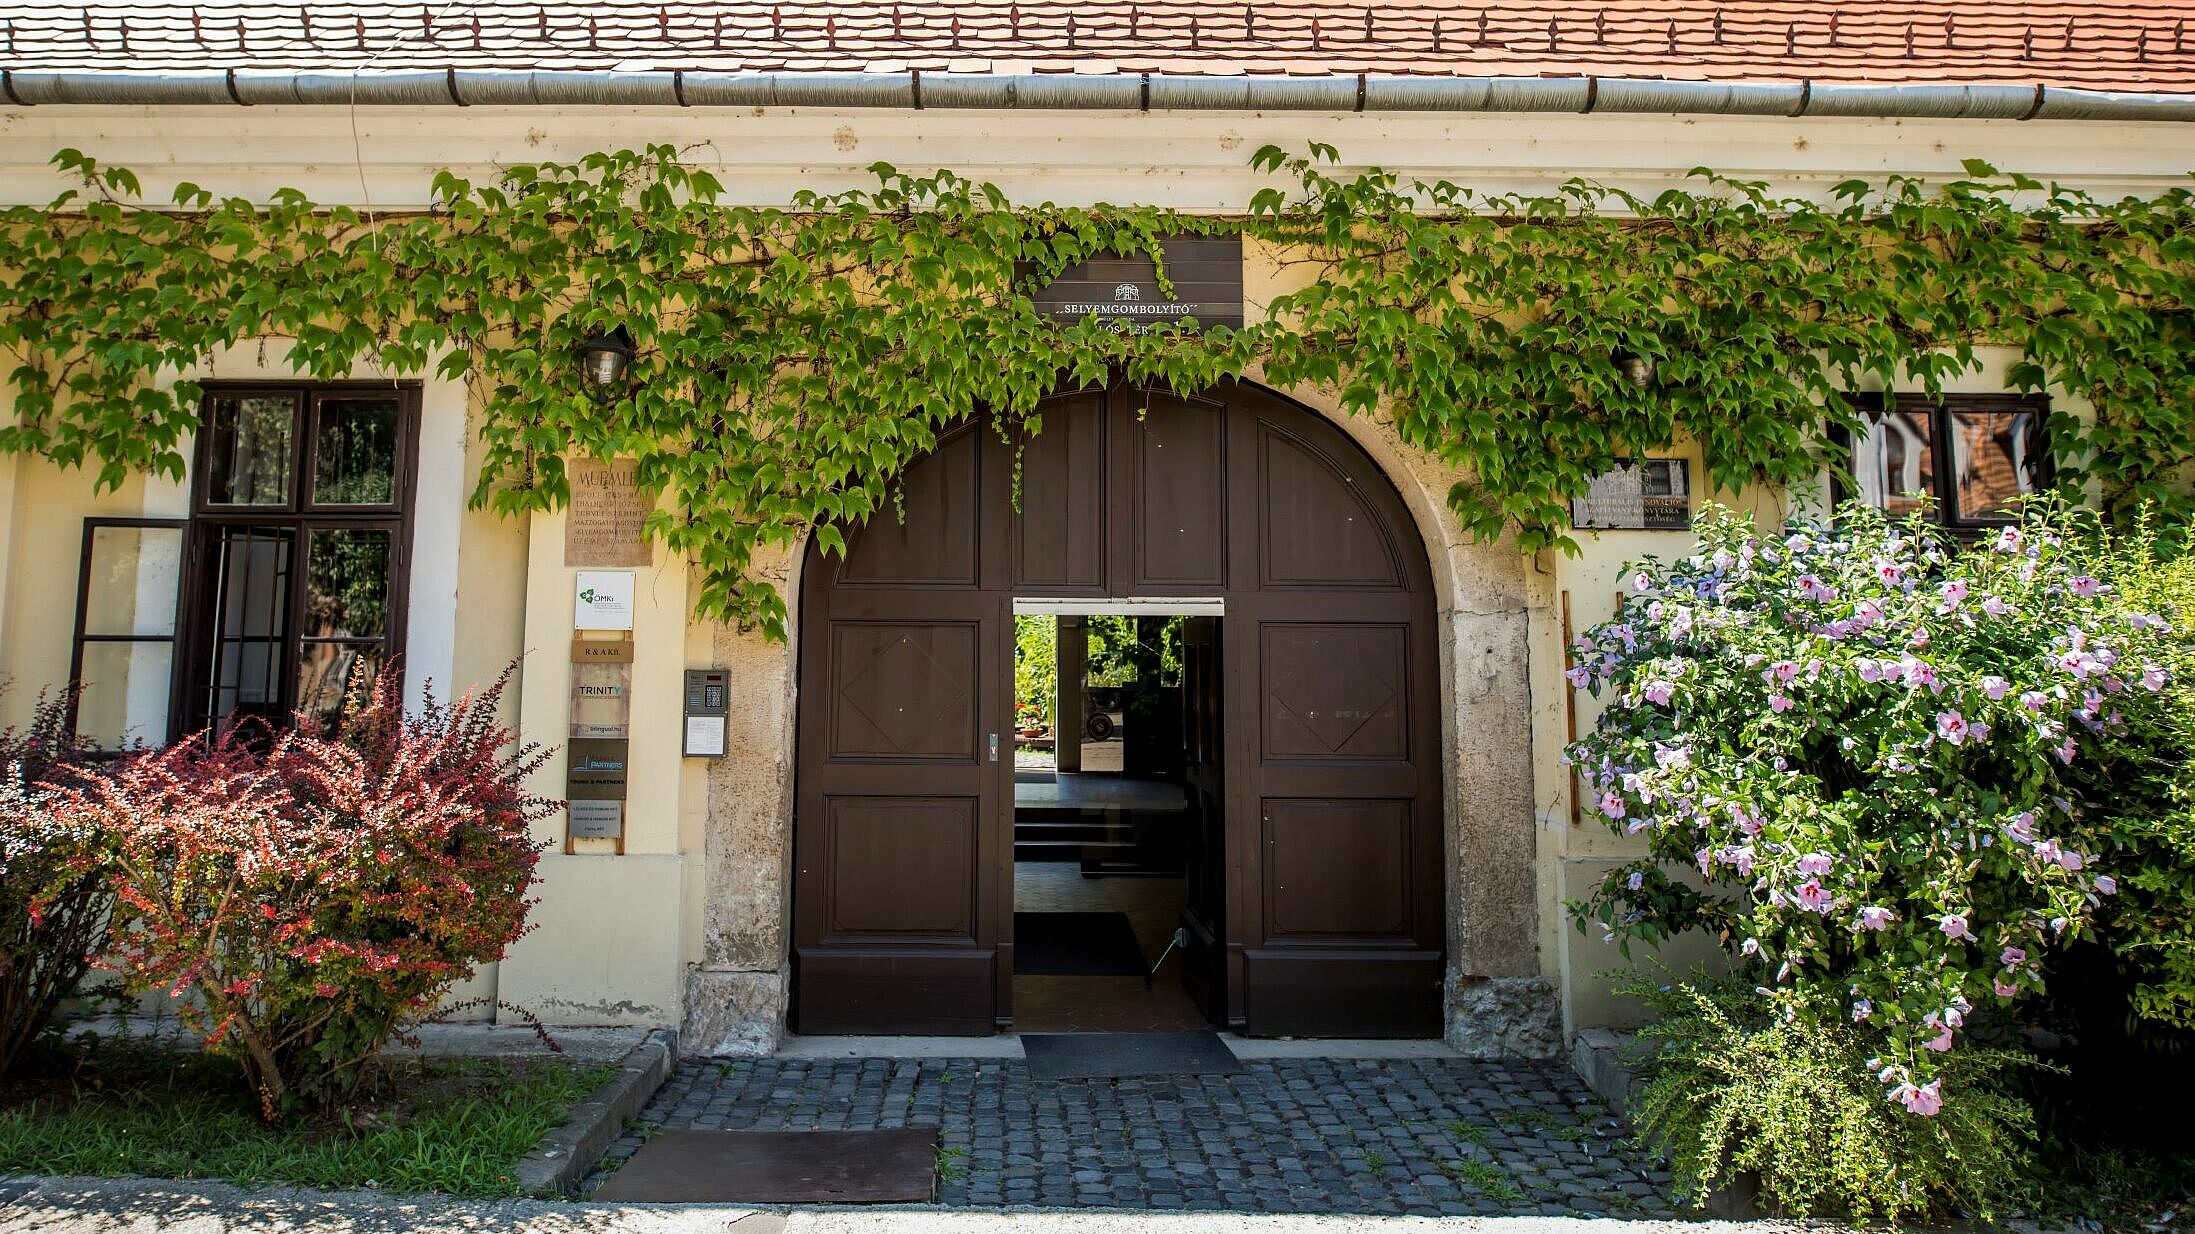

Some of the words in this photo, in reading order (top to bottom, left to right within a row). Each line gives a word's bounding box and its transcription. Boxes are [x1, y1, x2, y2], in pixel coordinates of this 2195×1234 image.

[585, 648, 591, 656] R
[592, 648, 599, 656] &
[600, 648, 606, 656] A
[579, 686, 622, 695] TRINITY
